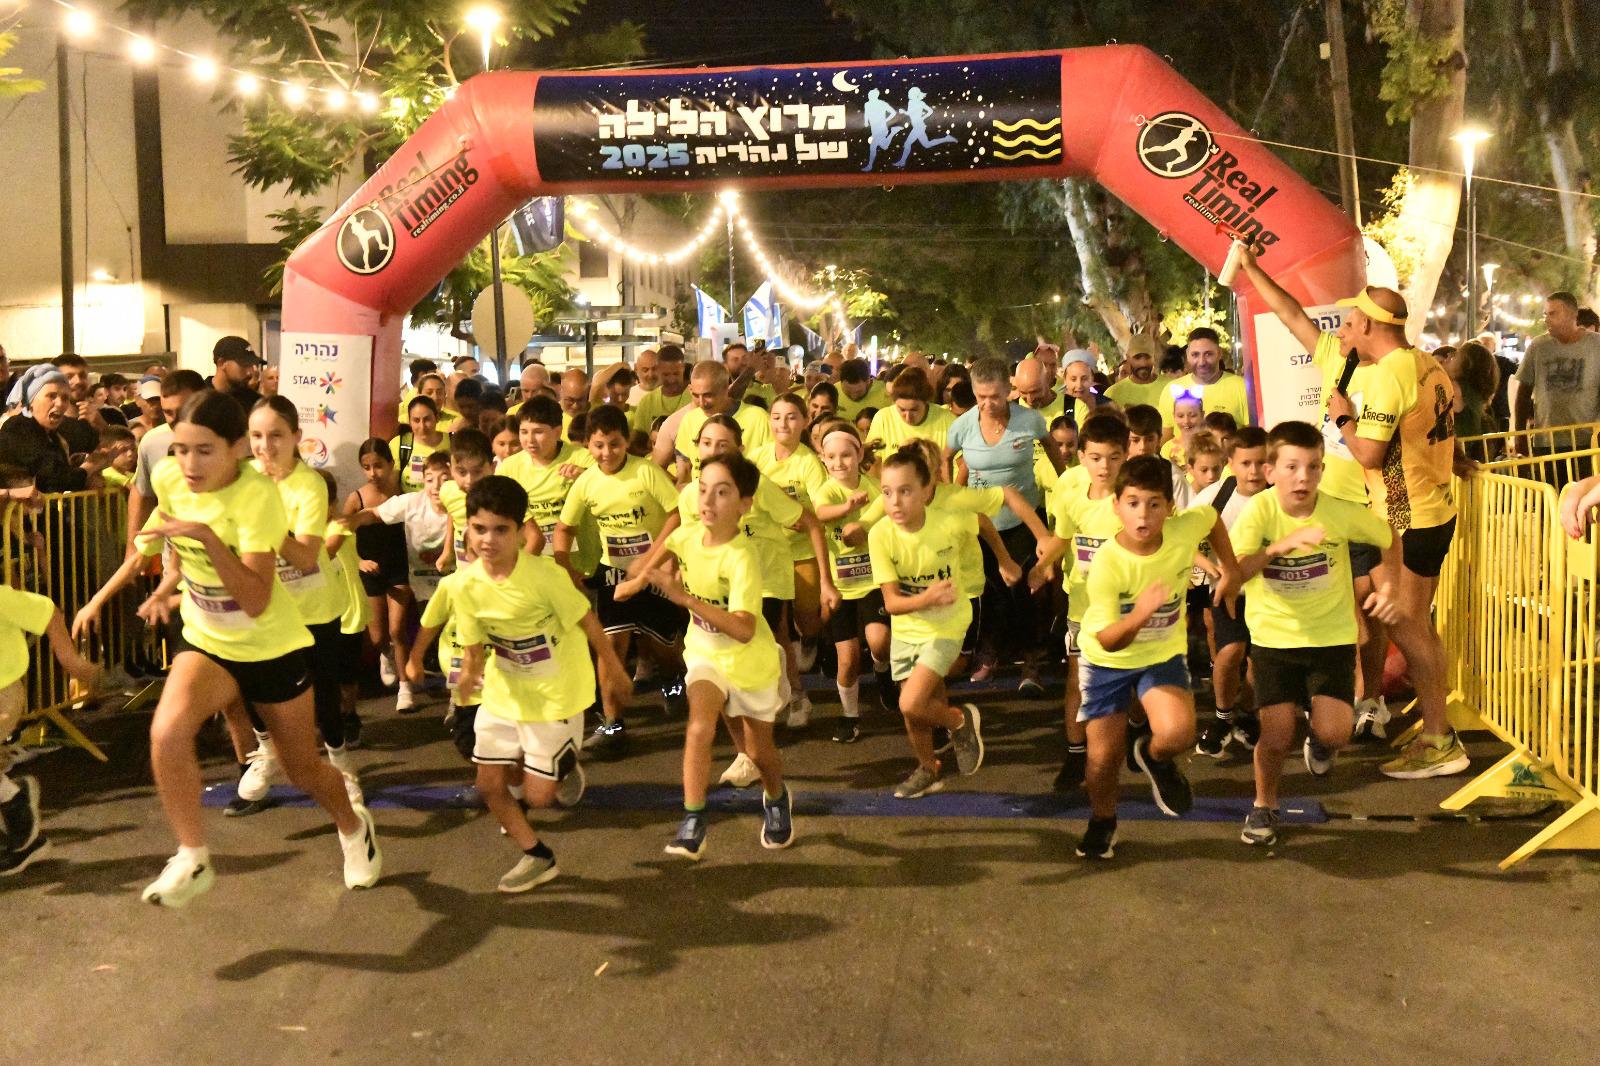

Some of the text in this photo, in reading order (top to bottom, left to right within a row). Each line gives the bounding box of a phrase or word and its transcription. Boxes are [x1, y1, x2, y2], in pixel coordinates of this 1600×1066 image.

[599, 98, 846, 140] מרוץ הלילה
[600, 143, 690, 170] 2025
[795, 134, 848, 161] של
[378, 150, 432, 212] Real
[390, 153, 479, 232] Timing
[1209, 151, 1279, 206] Real
[412, 184, 465, 237] realtiming.co.il
[1189, 169, 1280, 257] Timing
[295, 343, 338, 357] נהריה
[1290, 354, 1312, 365] STA
[293, 375, 317, 385] STAR
[1279, 571, 1310, 580] 4015
